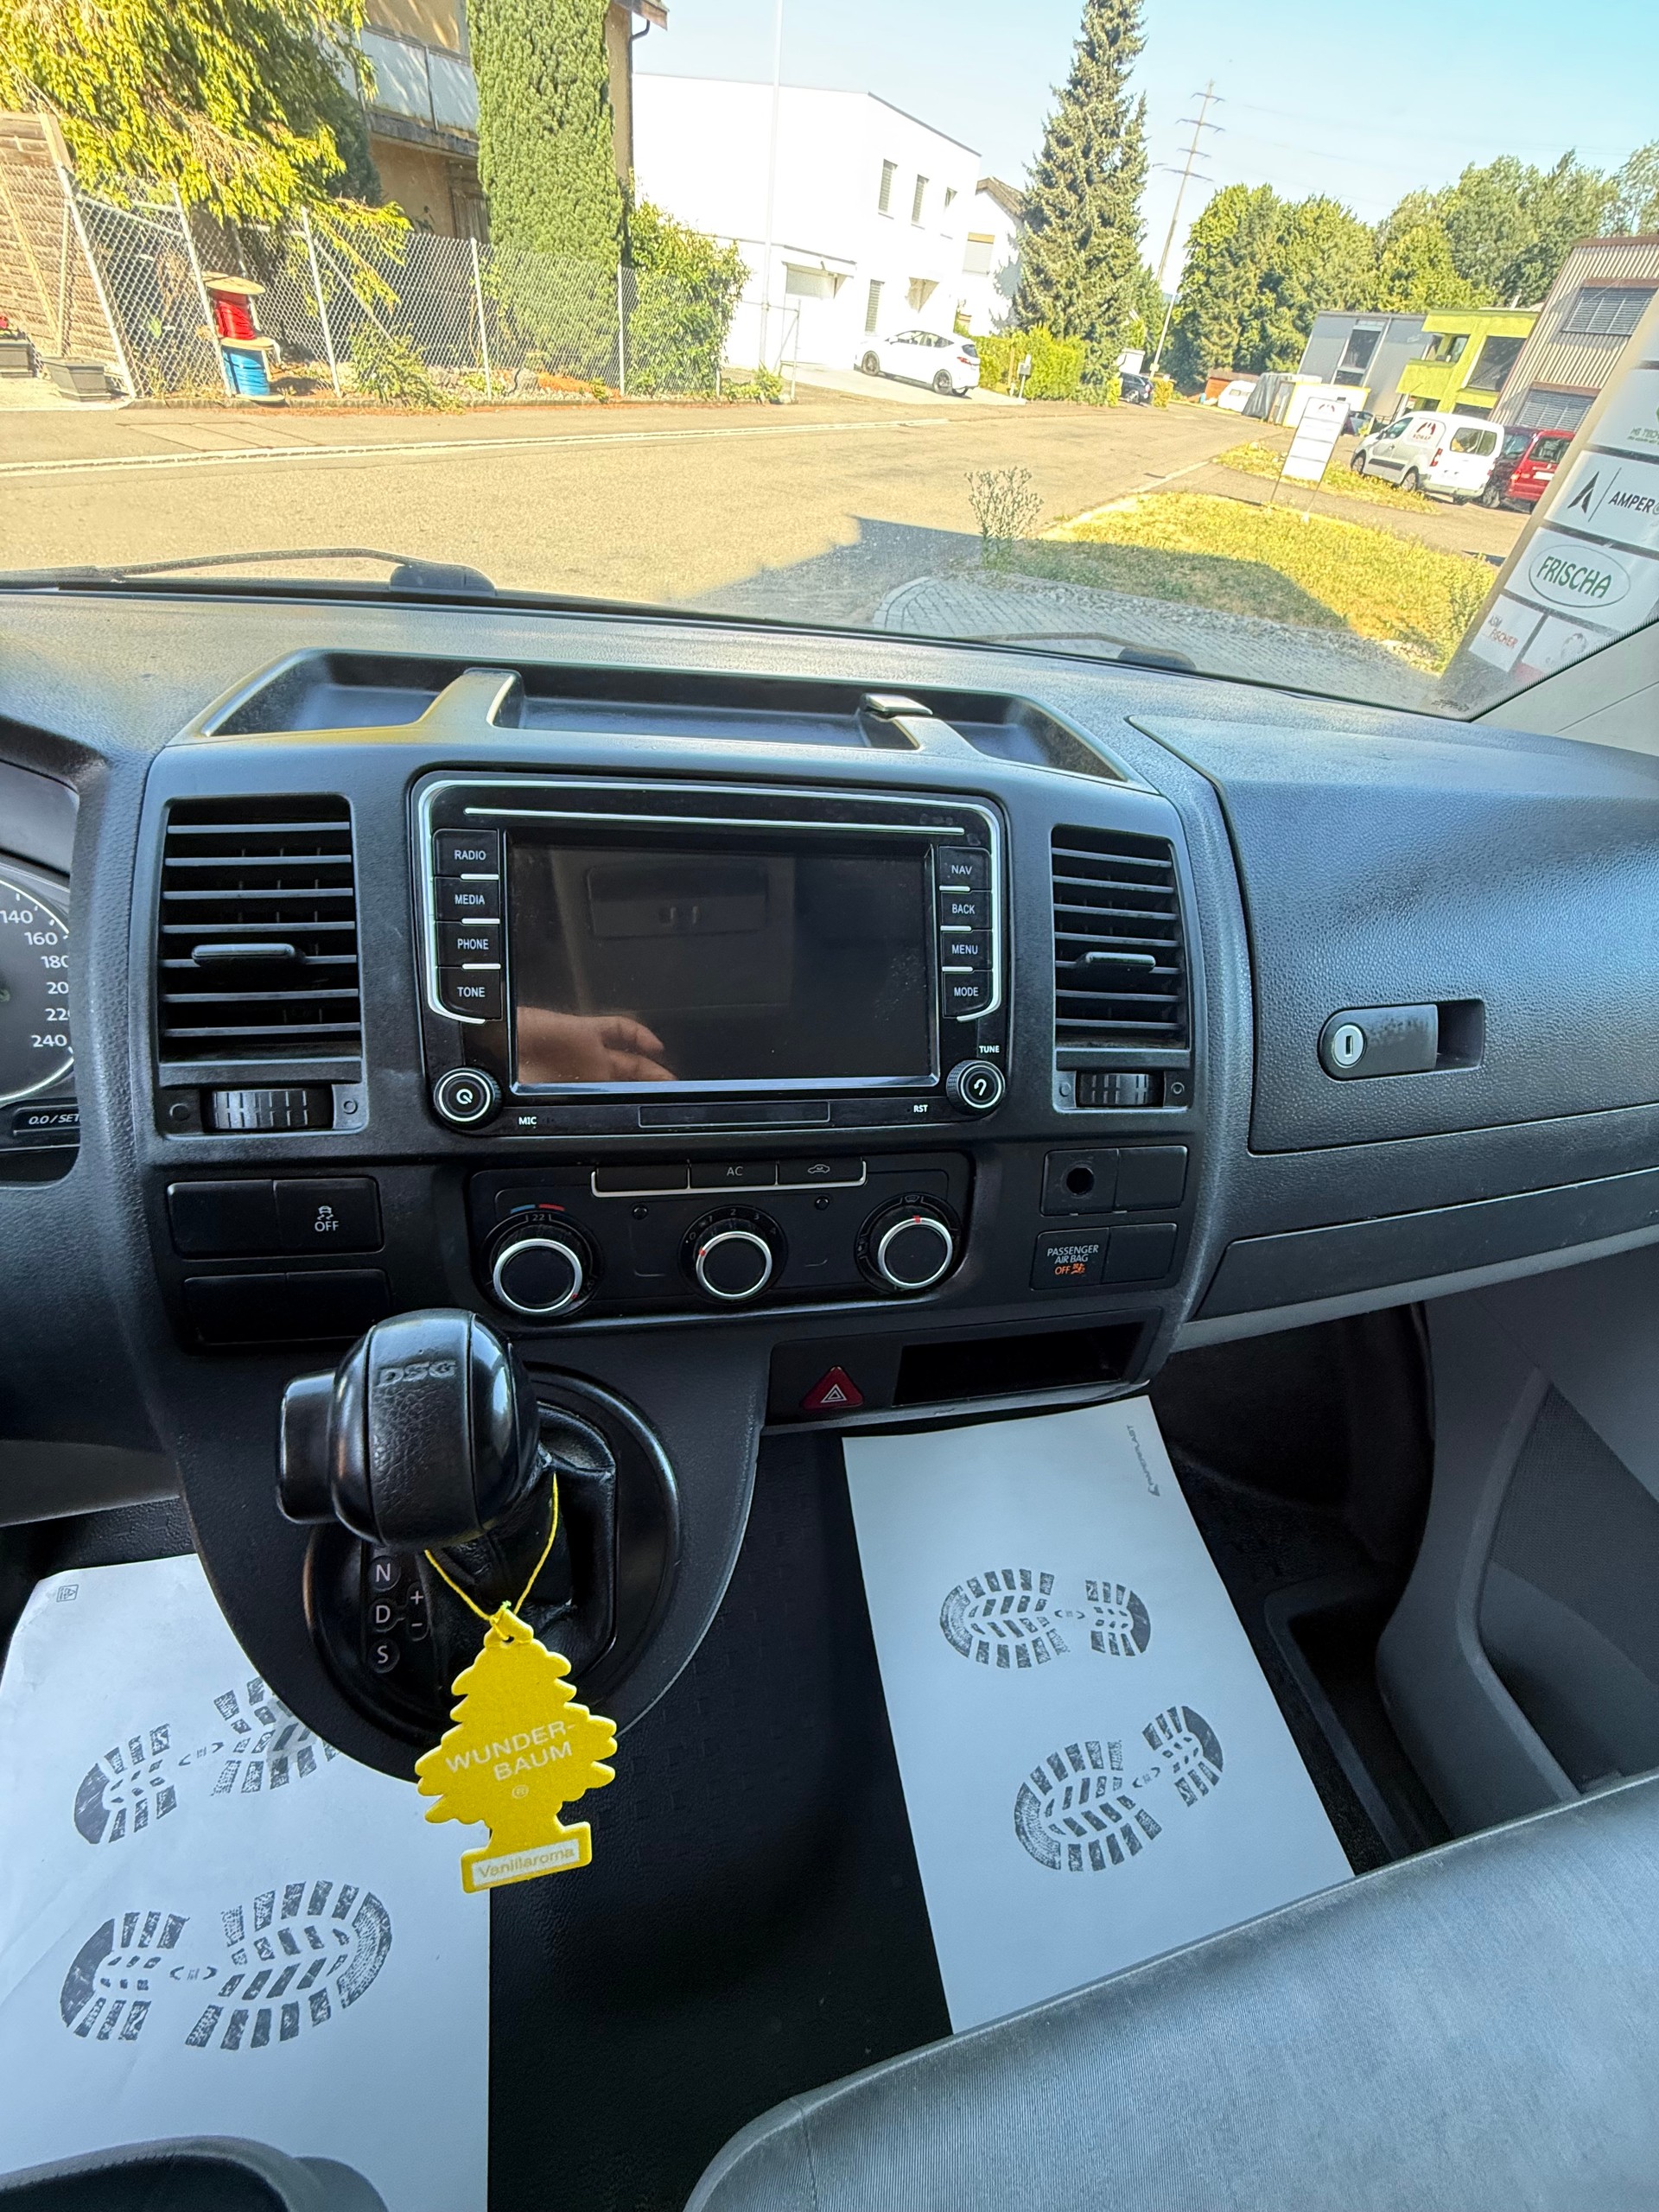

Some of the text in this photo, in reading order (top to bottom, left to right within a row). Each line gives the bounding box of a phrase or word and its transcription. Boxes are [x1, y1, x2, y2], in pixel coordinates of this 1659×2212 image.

[1536, 556, 1611, 599] FRISCHA
[454, 850, 486, 861] RADIO
[951, 865, 973, 875] NAV
[454, 894, 485, 905] MEDIA
[951, 904, 976, 915] BACK
[0, 910, 34, 924] 140
[24, 931, 58, 945] 160
[457, 938, 489, 950] PHONE
[951, 944, 978, 955] MENU
[46, 982, 69, 995] 20
[457, 986, 486, 998] TONE
[954, 987, 979, 997] MODE
[45, 1007, 70, 1021] 22
[31, 1034, 67, 1047] 240
[979, 1045, 1000, 1053] TUNE
[913, 1104, 928, 1114] RST
[518, 1116, 537, 1126] MIC
[726, 1166, 744, 1176] AC
[532, 1213, 545, 1222] 22
[315, 1220, 340, 1232] OFF
[1047, 1244, 1099, 1256] PASSENGER
[1054, 1254, 1089, 1264] AIR BAG
[1054, 1266, 1071, 1275] OFF
[374, 1361, 456, 1388] DSG
[375, 1563, 391, 1582] N
[375, 1605, 391, 1624] D
[377, 1645, 389, 1664] S
[493, 1741, 572, 1781] BAUM
[478, 1847, 575, 1878] Vanillaroma
